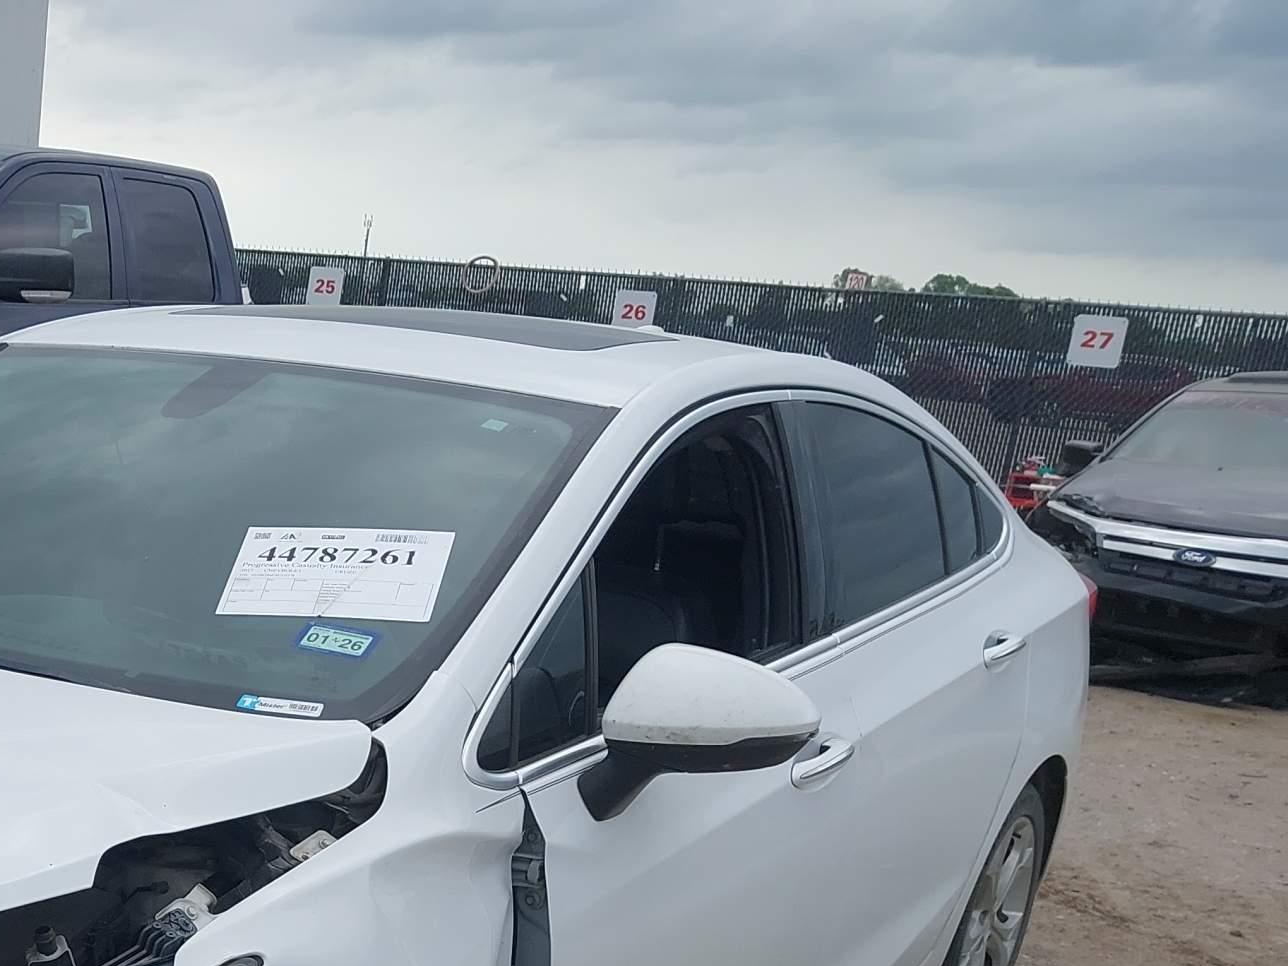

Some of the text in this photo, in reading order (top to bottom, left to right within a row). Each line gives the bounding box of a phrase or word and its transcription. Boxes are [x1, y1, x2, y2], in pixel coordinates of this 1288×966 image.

[314, 278, 336, 294] 25
[620, 304, 647, 321] 26
[1080, 330, 1115, 349] 27
[257, 546, 416, 566] 44787261
[306, 632, 330, 645] 01
[337, 638, 365, 652] 26
